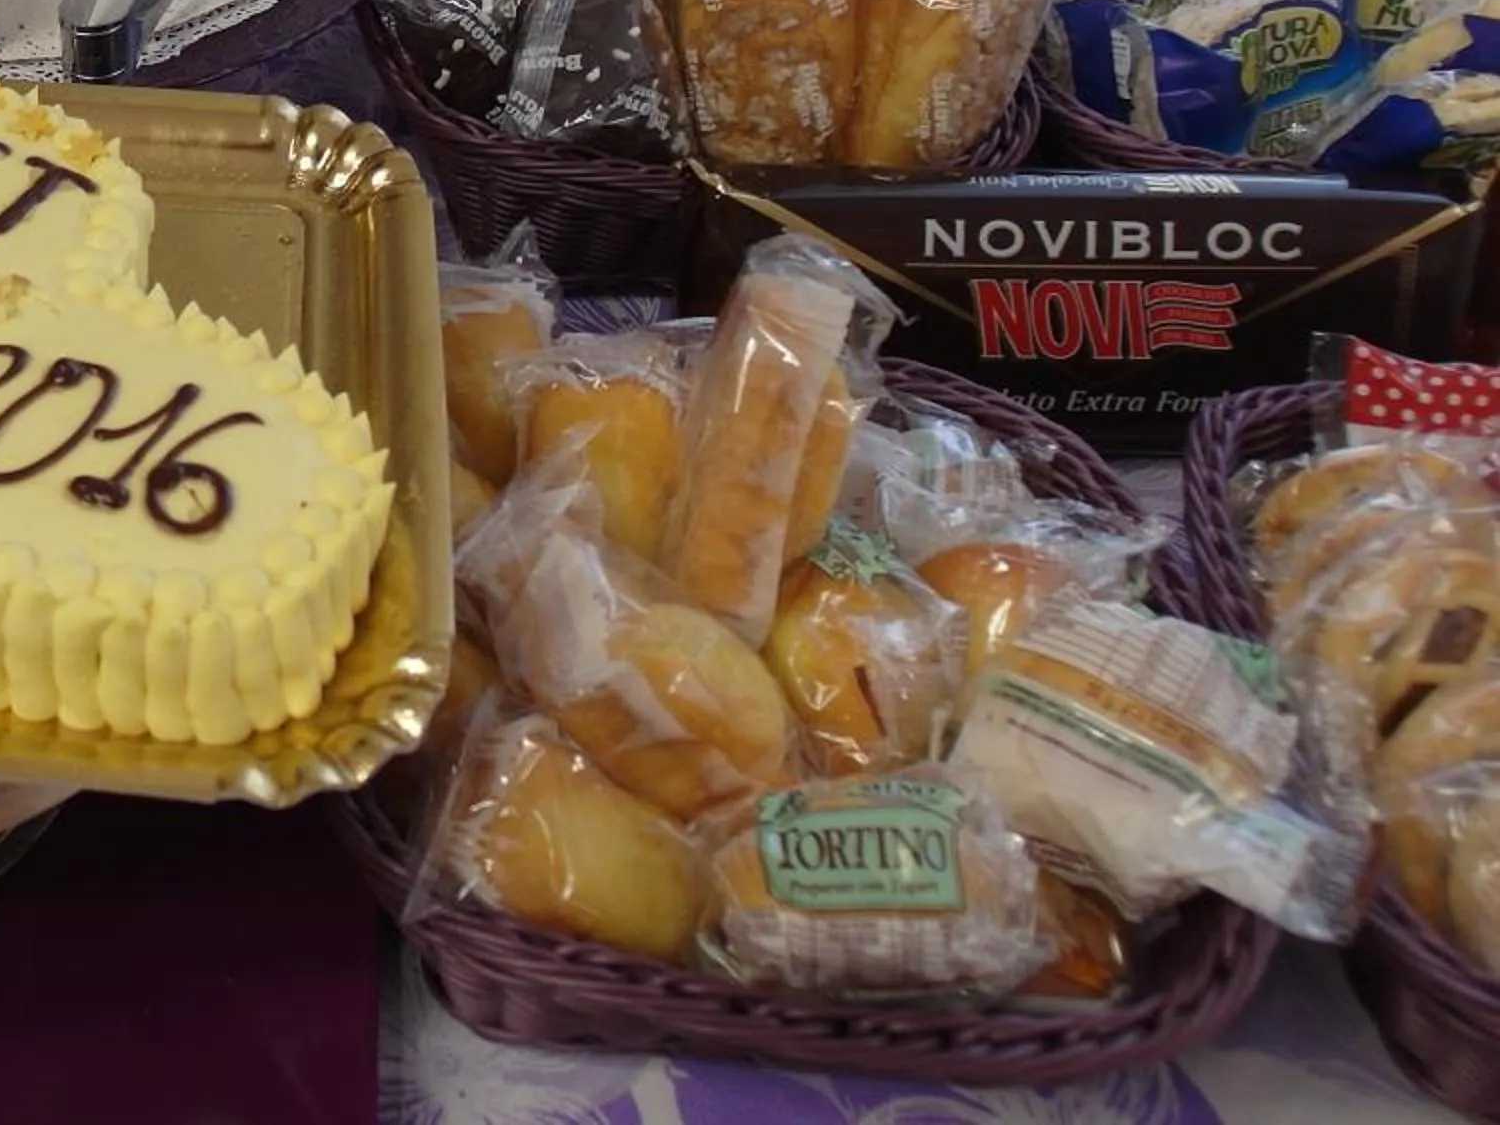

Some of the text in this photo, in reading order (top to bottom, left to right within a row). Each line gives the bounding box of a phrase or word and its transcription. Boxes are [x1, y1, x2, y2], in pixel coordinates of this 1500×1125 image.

[922, 217, 1304, 261] NOVIBLOC
[970, 278, 1152, 360] NOVI
[1066, 389, 1147, 413] Extra
[776, 826, 948, 873] TORTINO
